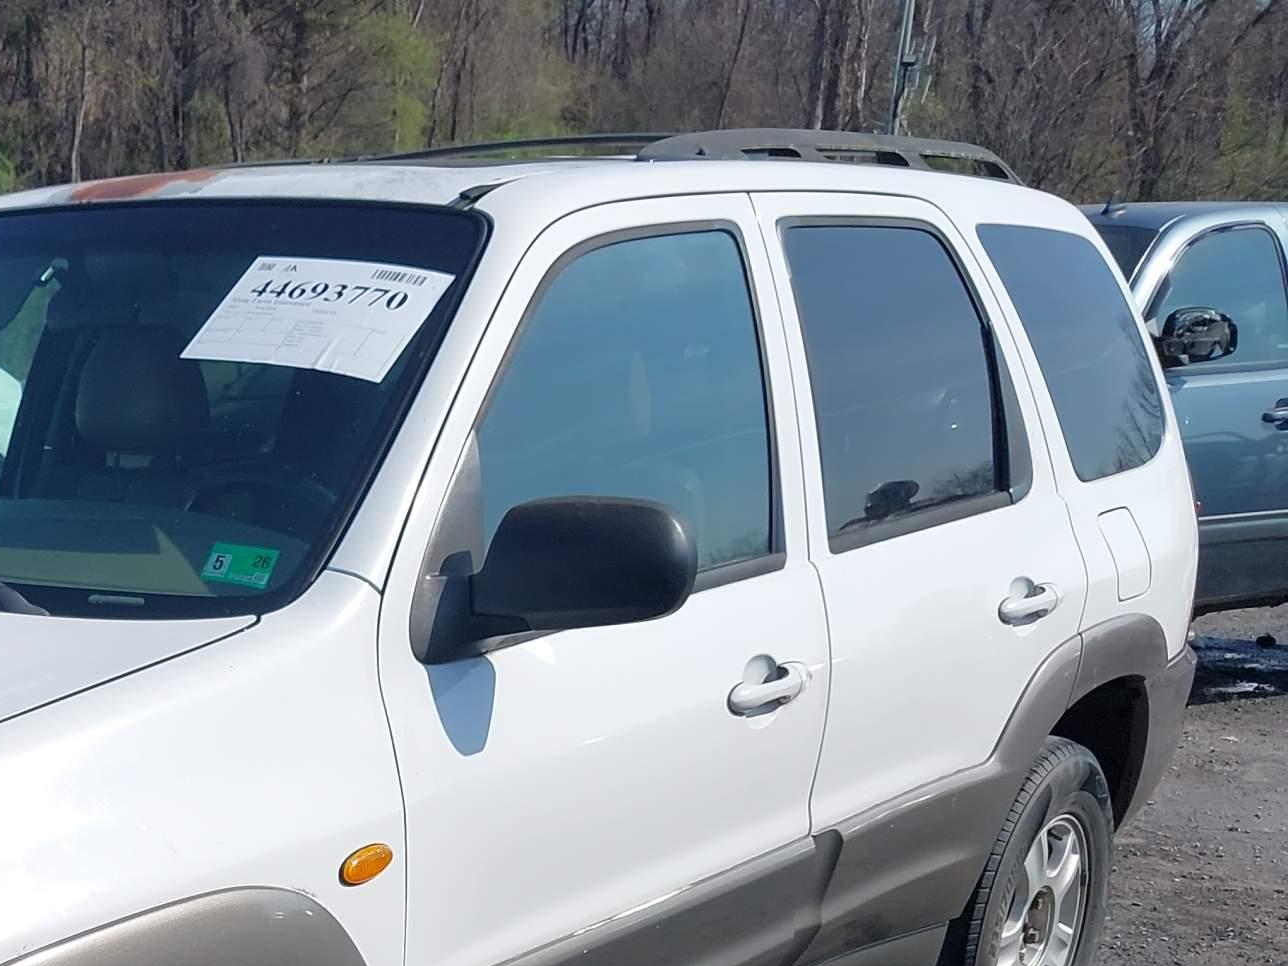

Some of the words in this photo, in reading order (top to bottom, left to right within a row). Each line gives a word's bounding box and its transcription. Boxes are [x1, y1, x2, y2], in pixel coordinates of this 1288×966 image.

[250, 279, 410, 312] 44693770
[212, 554, 227, 571] 5
[251, 554, 272, 569] 26
